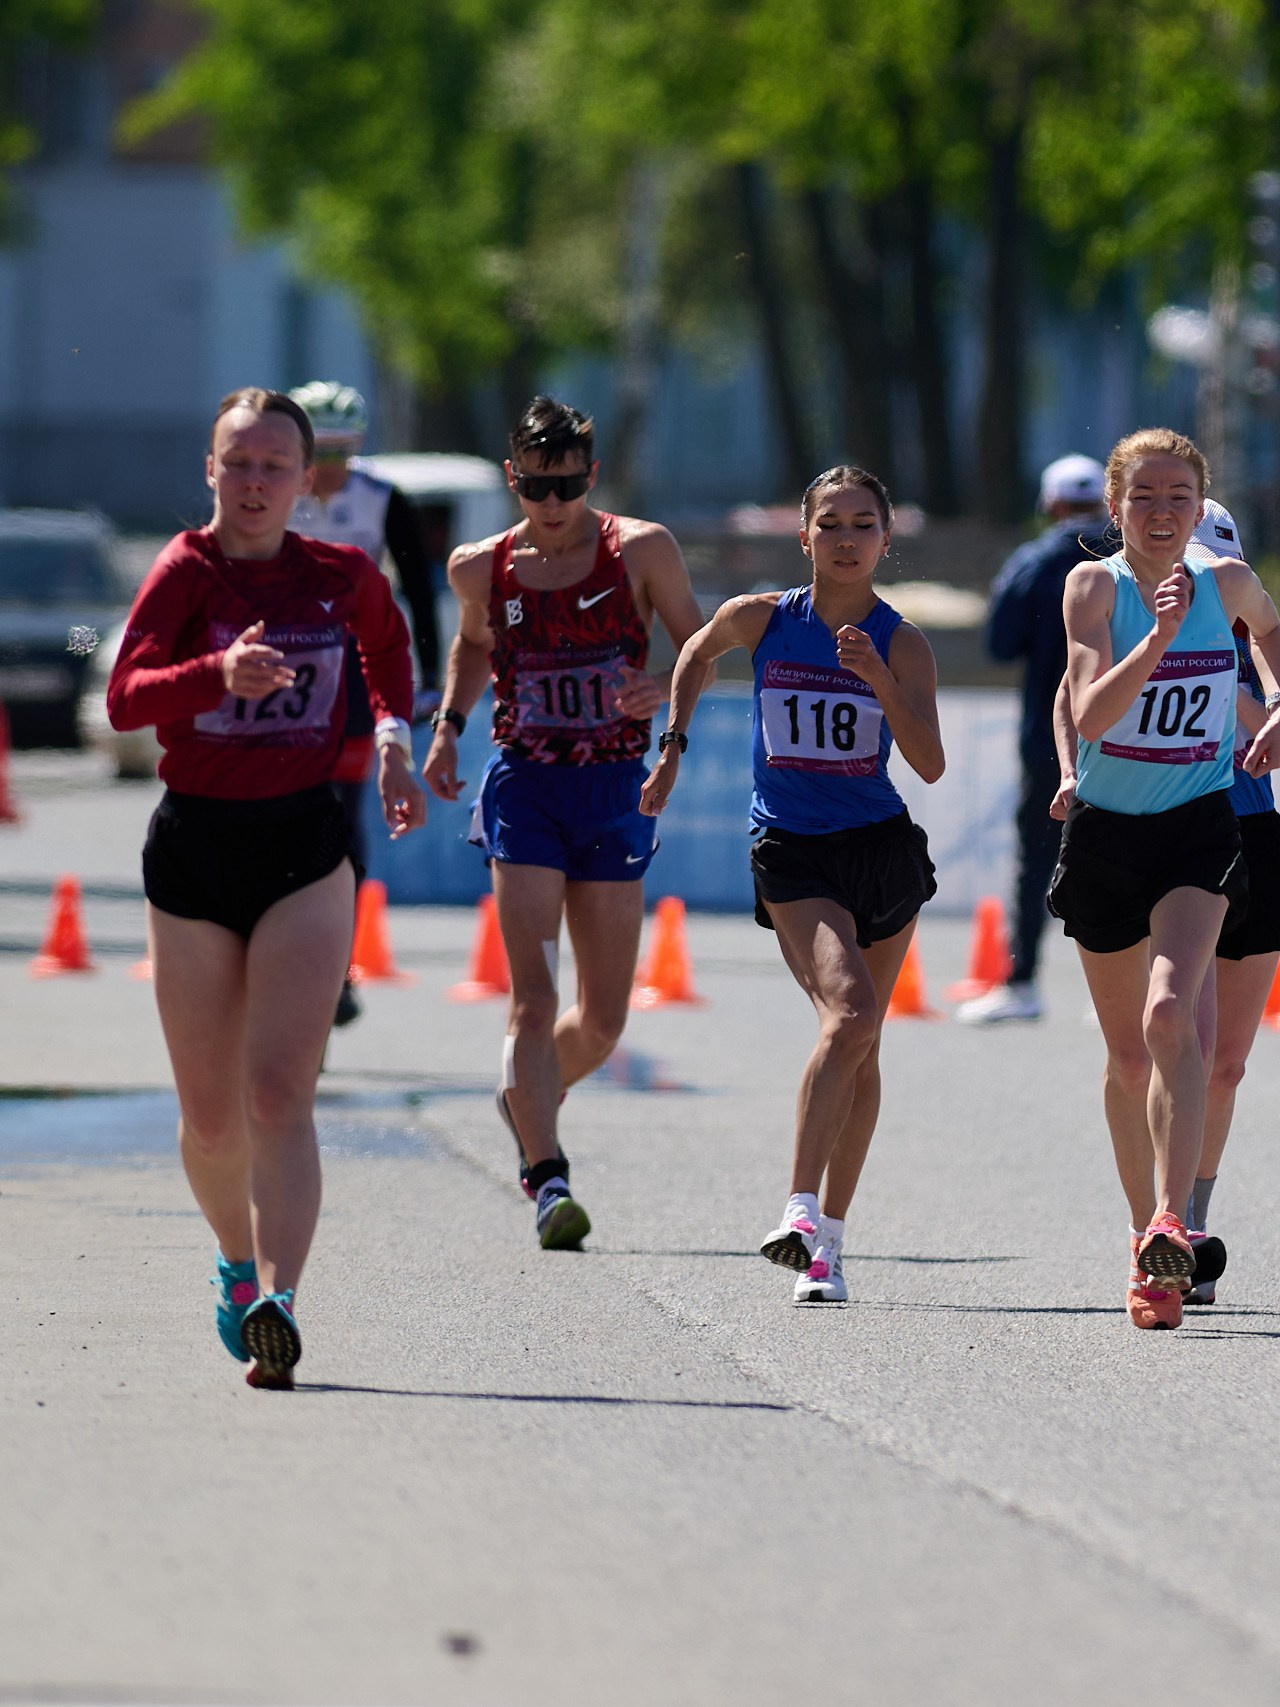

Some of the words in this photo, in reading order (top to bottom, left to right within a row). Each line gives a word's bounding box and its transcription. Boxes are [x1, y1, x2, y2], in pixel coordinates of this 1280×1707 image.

[768, 667, 830, 683] ЧЕМПИОНАТ
[833, 676, 873, 692] РОССИИ
[1188, 658, 1227, 667] РОССИИ
[538, 673, 604, 720] 101
[1138, 685, 1211, 738] 102
[783, 694, 858, 752] 118
